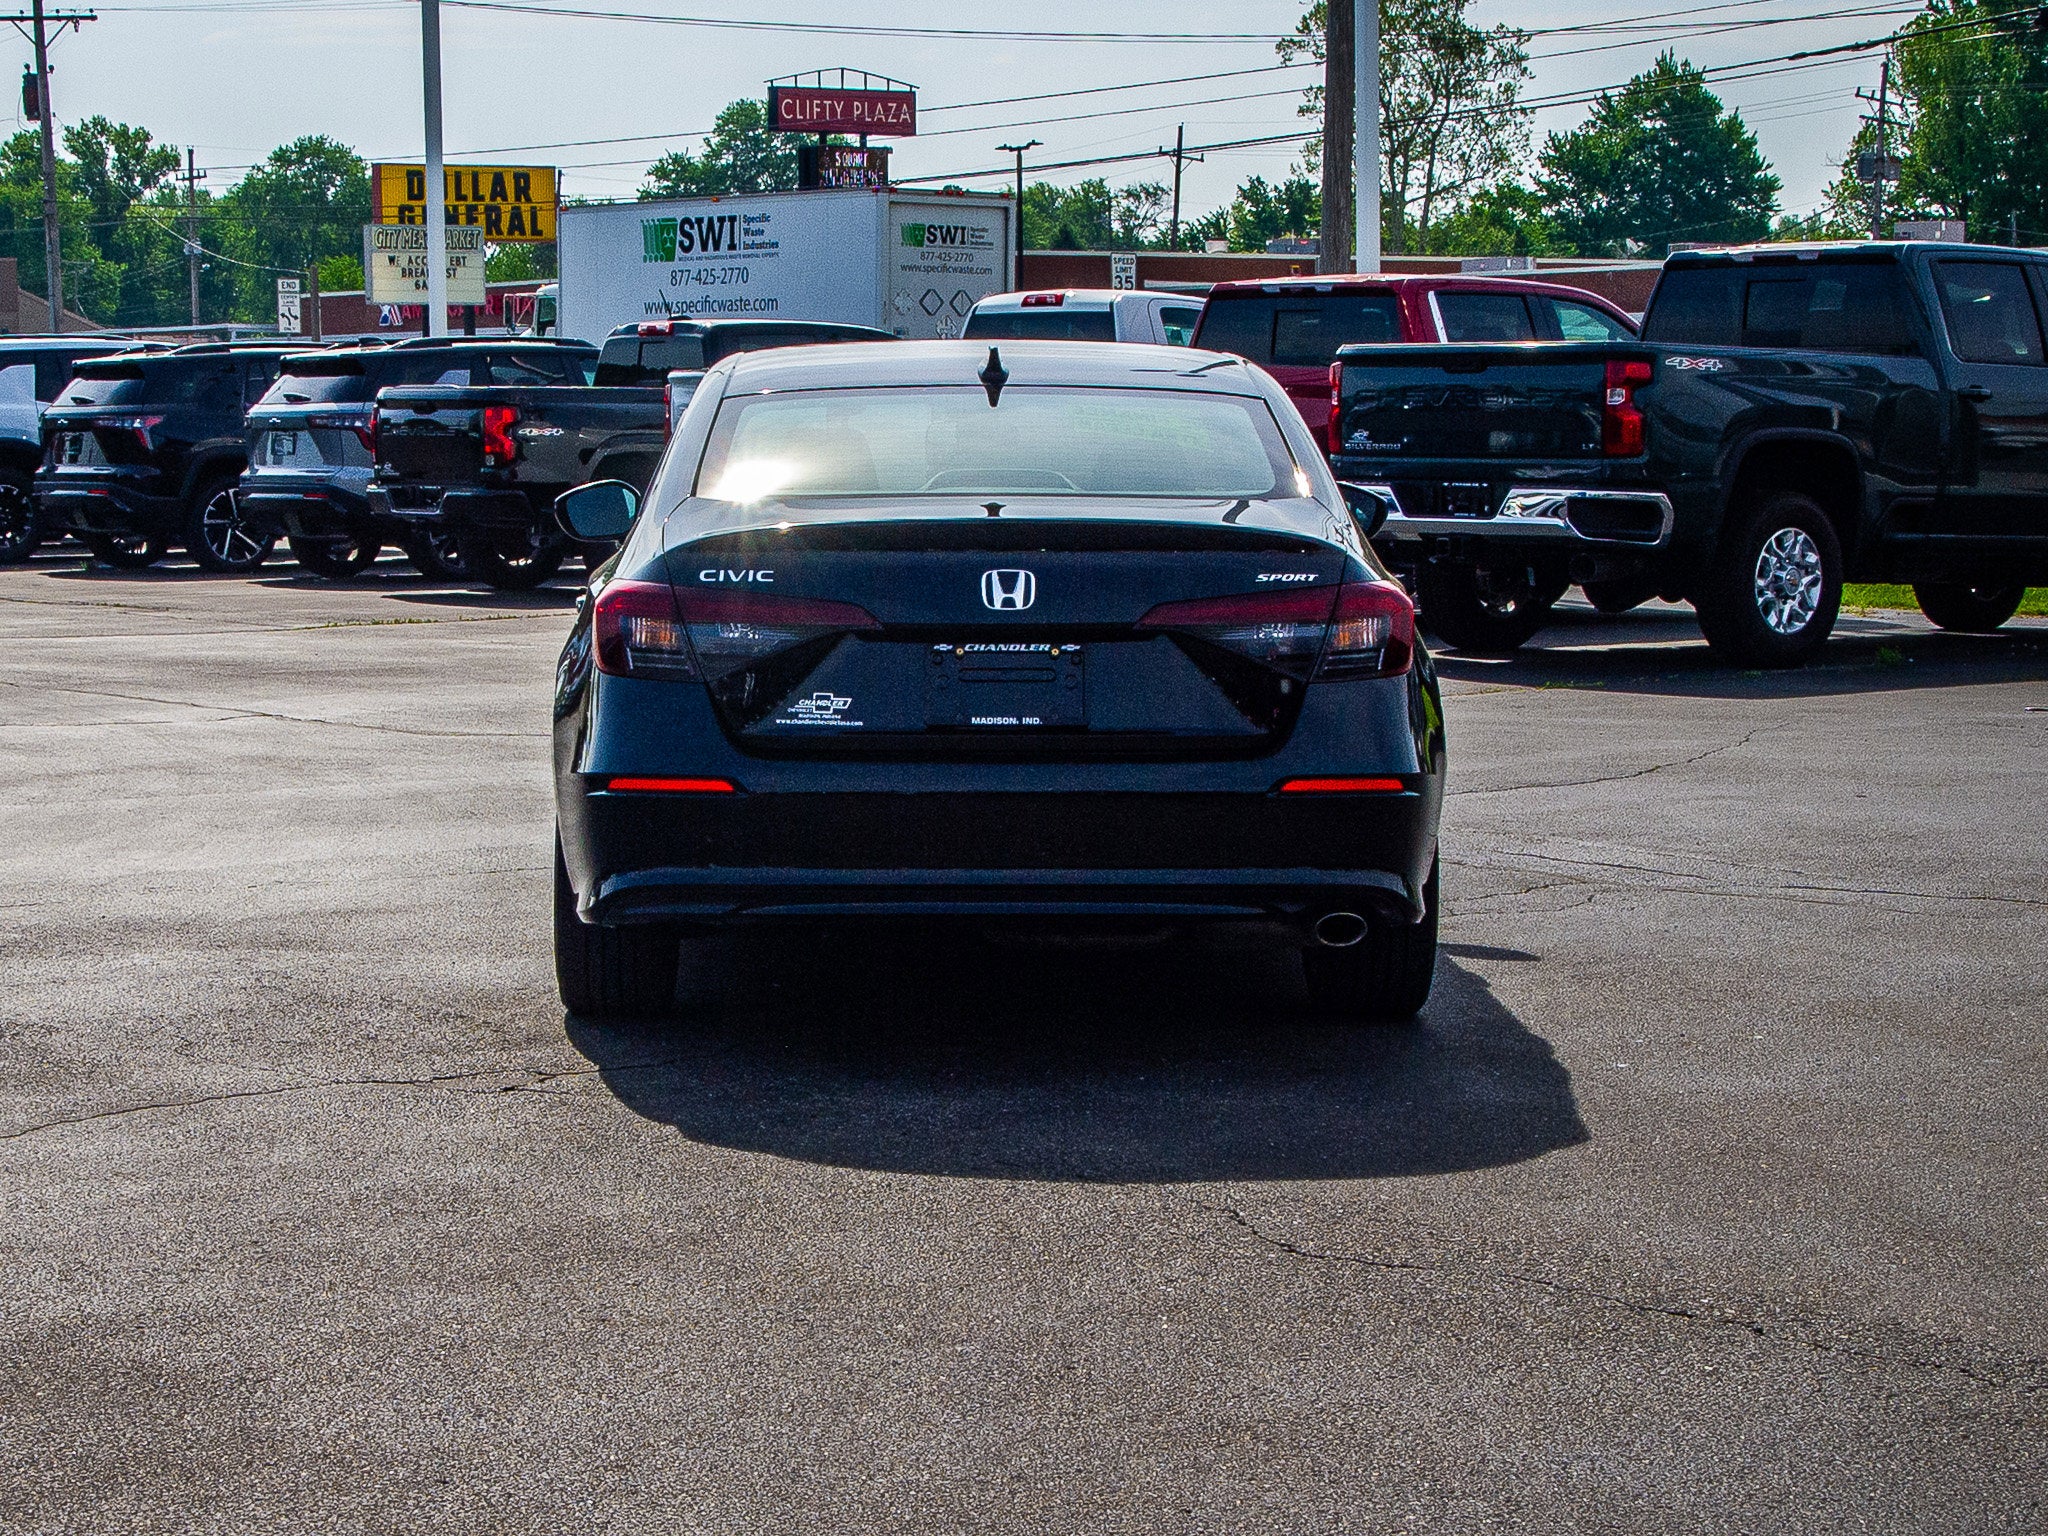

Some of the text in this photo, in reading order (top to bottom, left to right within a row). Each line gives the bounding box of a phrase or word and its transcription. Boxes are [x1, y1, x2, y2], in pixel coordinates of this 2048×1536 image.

[781, 99, 911, 123] CLIFTY PLAZA
[406, 169, 533, 203] DLLAR
[743, 213, 771, 225] Specific
[679, 214, 738, 254] SWI
[743, 228, 765, 237] Waste
[926, 224, 967, 245] SWI
[375, 228, 480, 250] CITY MEA ARKET
[743, 240, 780, 250] Industries
[920, 251, 974, 262] 877-425-2770
[1113, 257, 1135, 265] SPEED
[670, 266, 749, 286] 877-425-2770
[281, 281, 297, 289] END
[1114, 275, 1134, 290] 35
[644, 295, 779, 315] www.specificwaste.com
[699, 569, 774, 582] CIVIC
[1255, 573, 1319, 582] SPORT
[964, 643, 1051, 652] CHANDLER
[798, 699, 845, 707] CHANDLER
[1022, 716, 1043, 725] IND.
